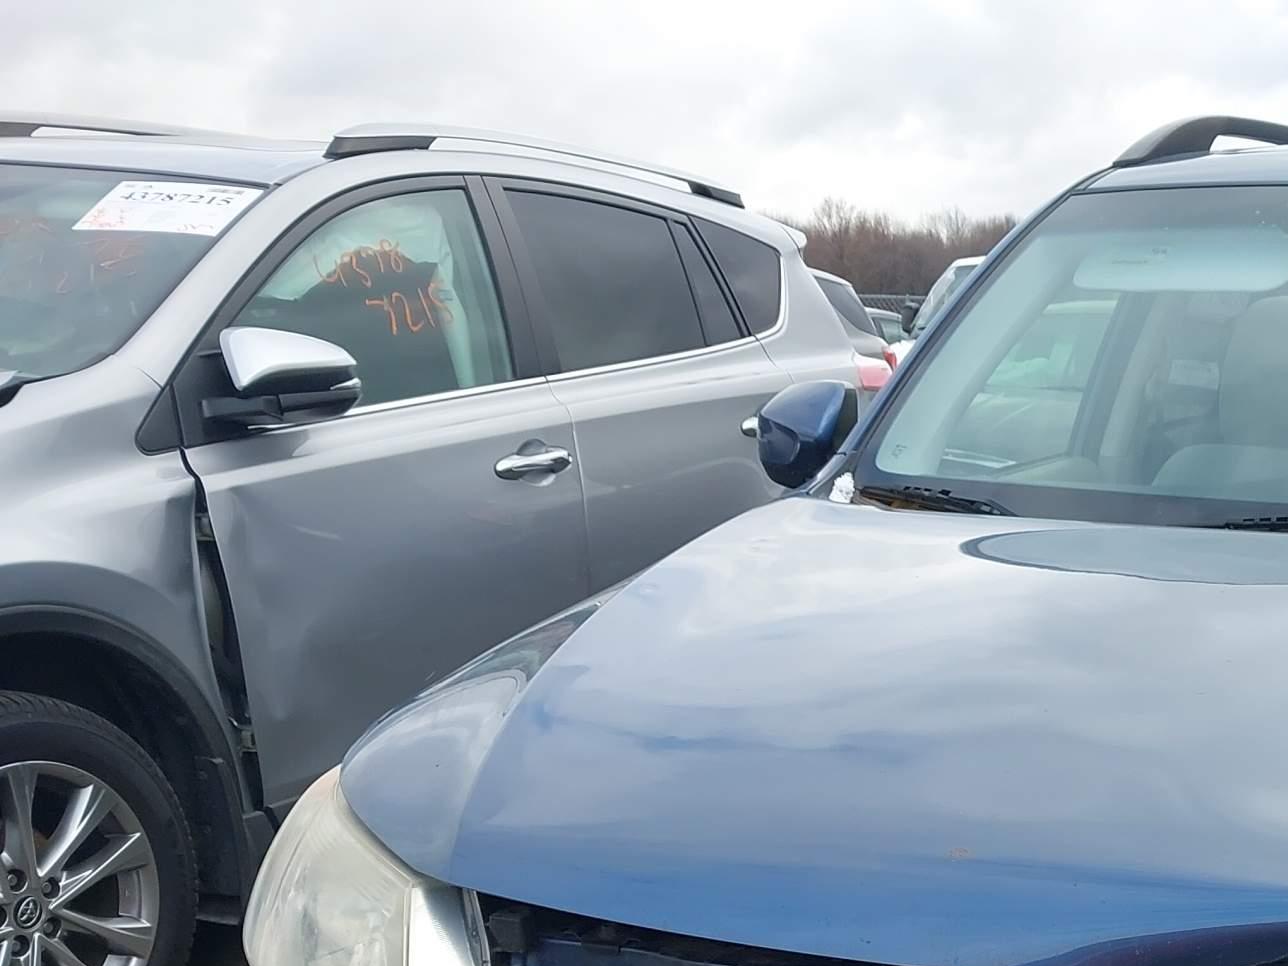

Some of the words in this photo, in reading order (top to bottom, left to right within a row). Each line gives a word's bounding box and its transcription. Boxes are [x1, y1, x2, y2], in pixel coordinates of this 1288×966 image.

[120, 192, 232, 206] 43787215
[313, 239, 404, 289] 4378
[366, 282, 454, 337] 7215
